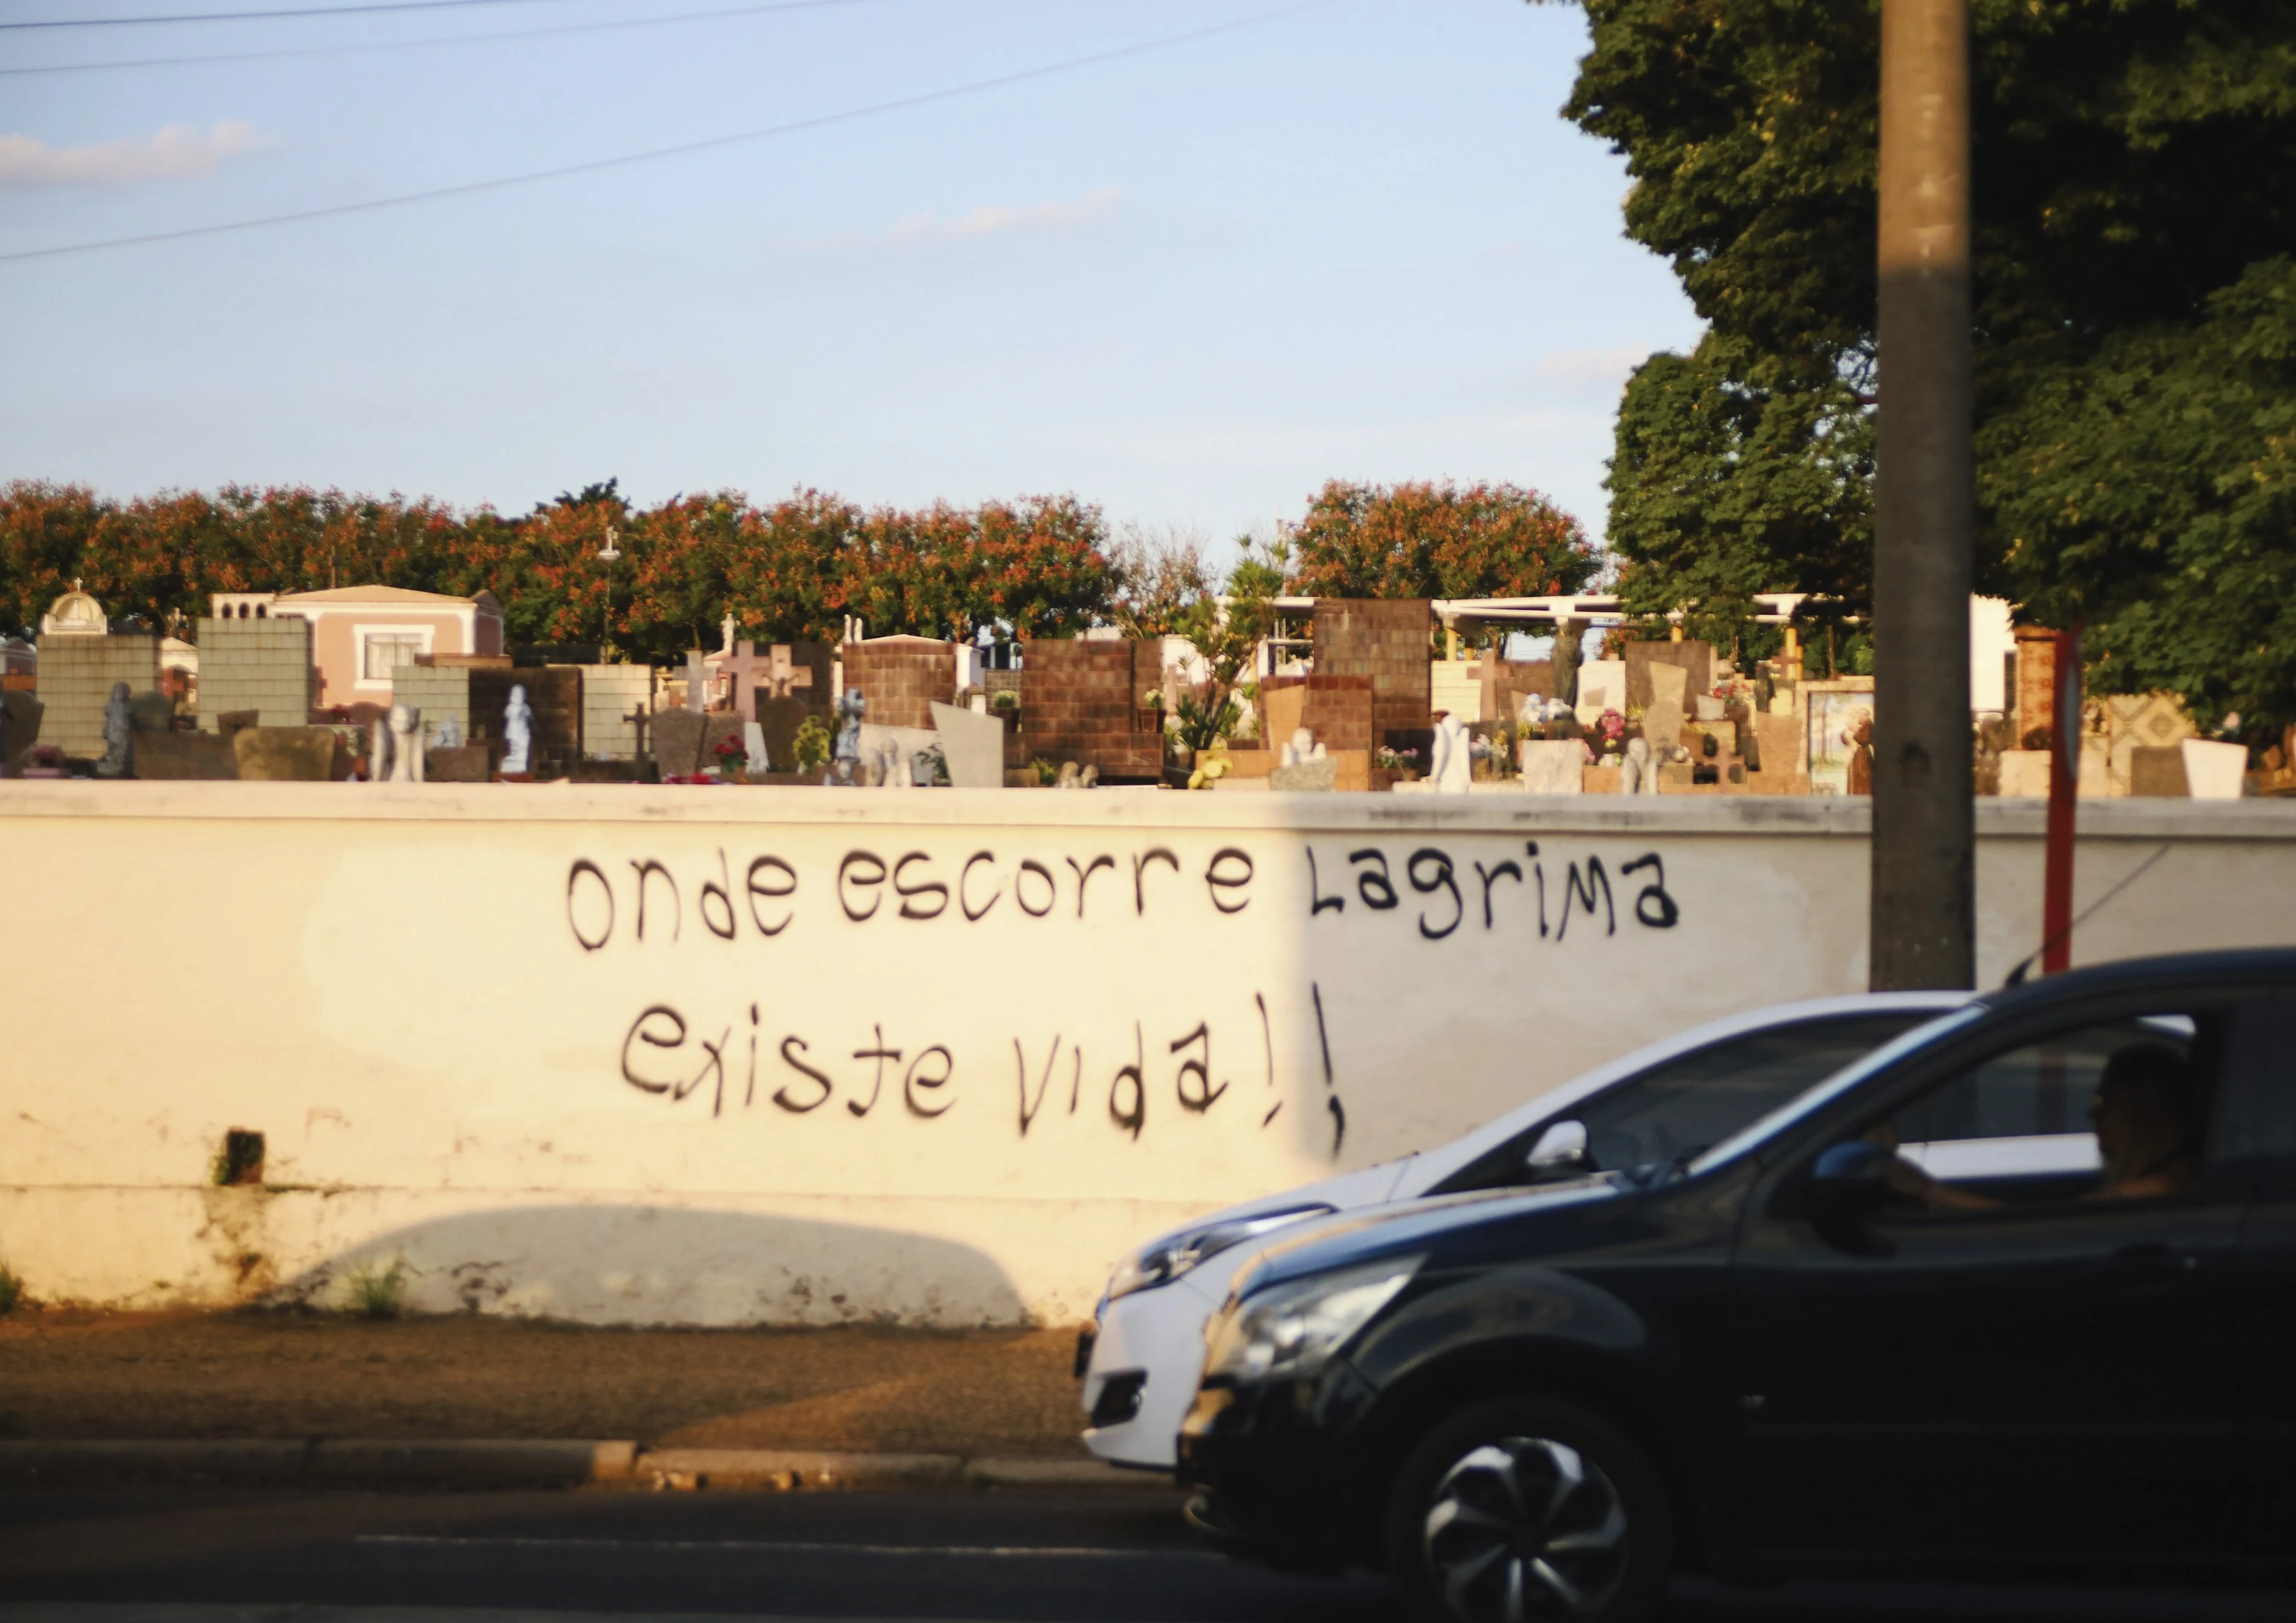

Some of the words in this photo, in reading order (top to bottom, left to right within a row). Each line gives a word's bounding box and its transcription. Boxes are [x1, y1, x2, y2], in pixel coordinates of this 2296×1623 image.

[566, 846, 798, 952] onde
[837, 846, 1254, 924] escorre
[620, 1002, 957, 1120] existe
